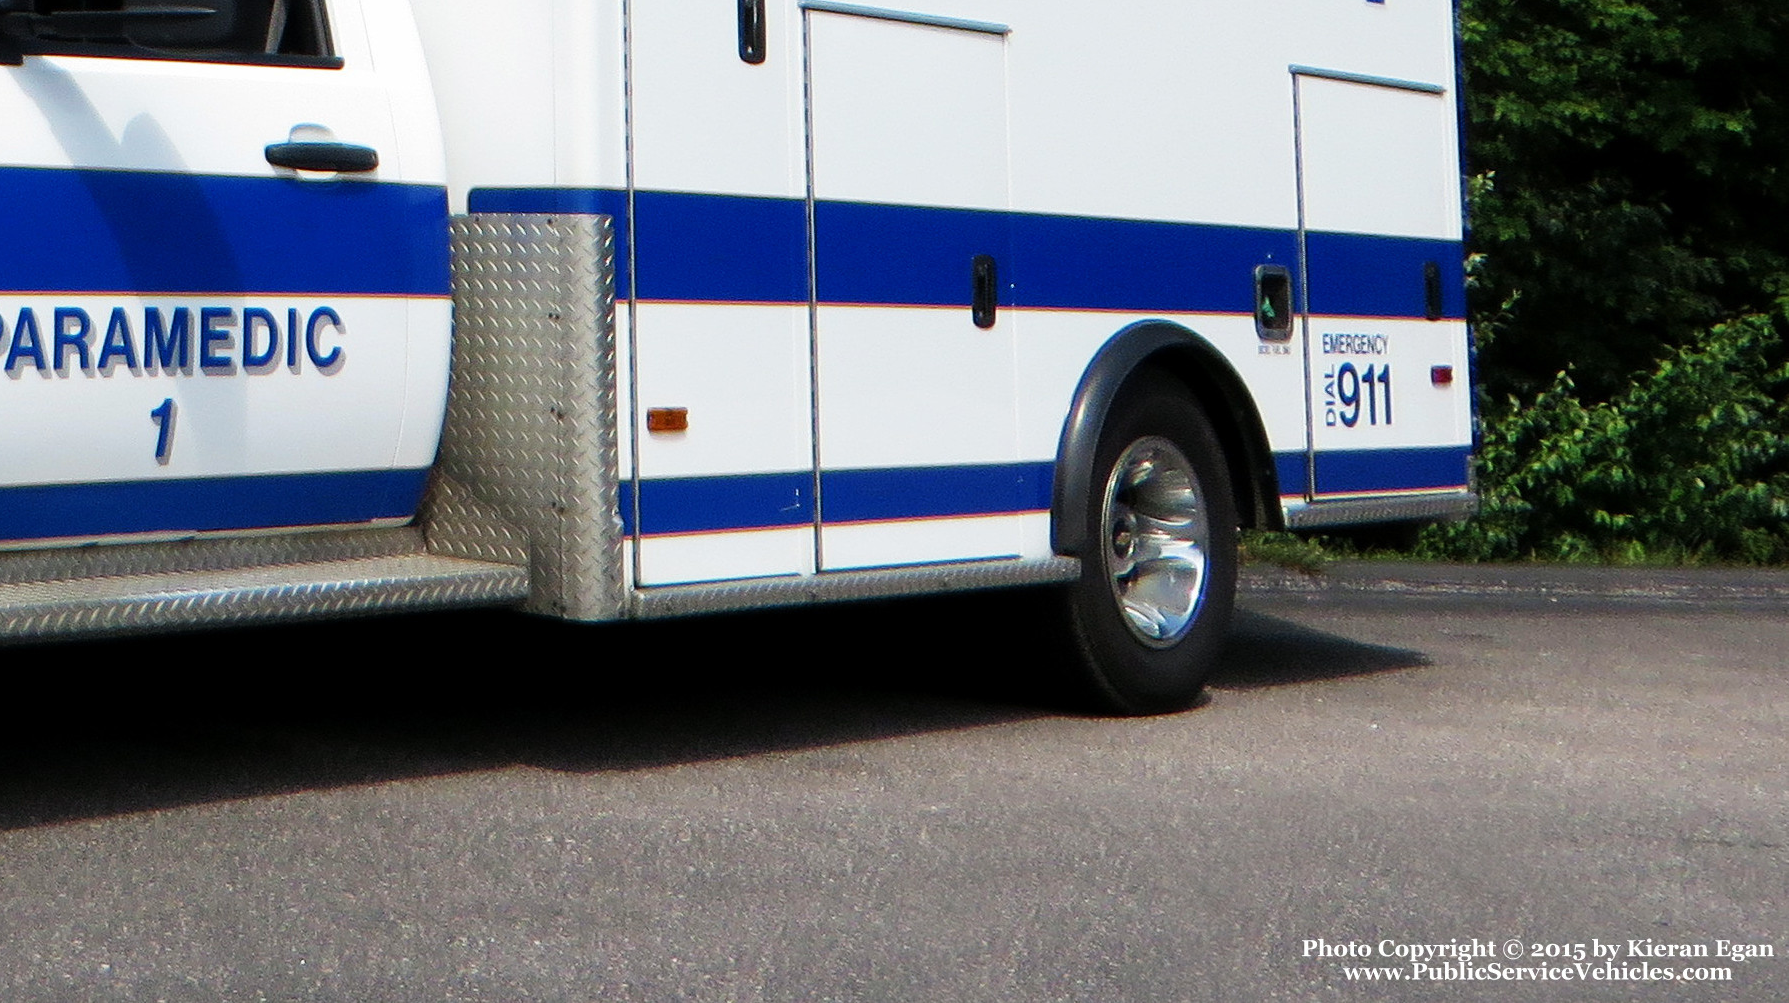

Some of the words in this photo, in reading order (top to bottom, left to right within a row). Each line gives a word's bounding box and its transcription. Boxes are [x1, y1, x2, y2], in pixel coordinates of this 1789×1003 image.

[1322, 333, 1390, 355] EMERGENCY
[1324, 364, 1337, 427] DIAL
[1337, 361, 1393, 428] 911
[150, 398, 178, 466] 1
